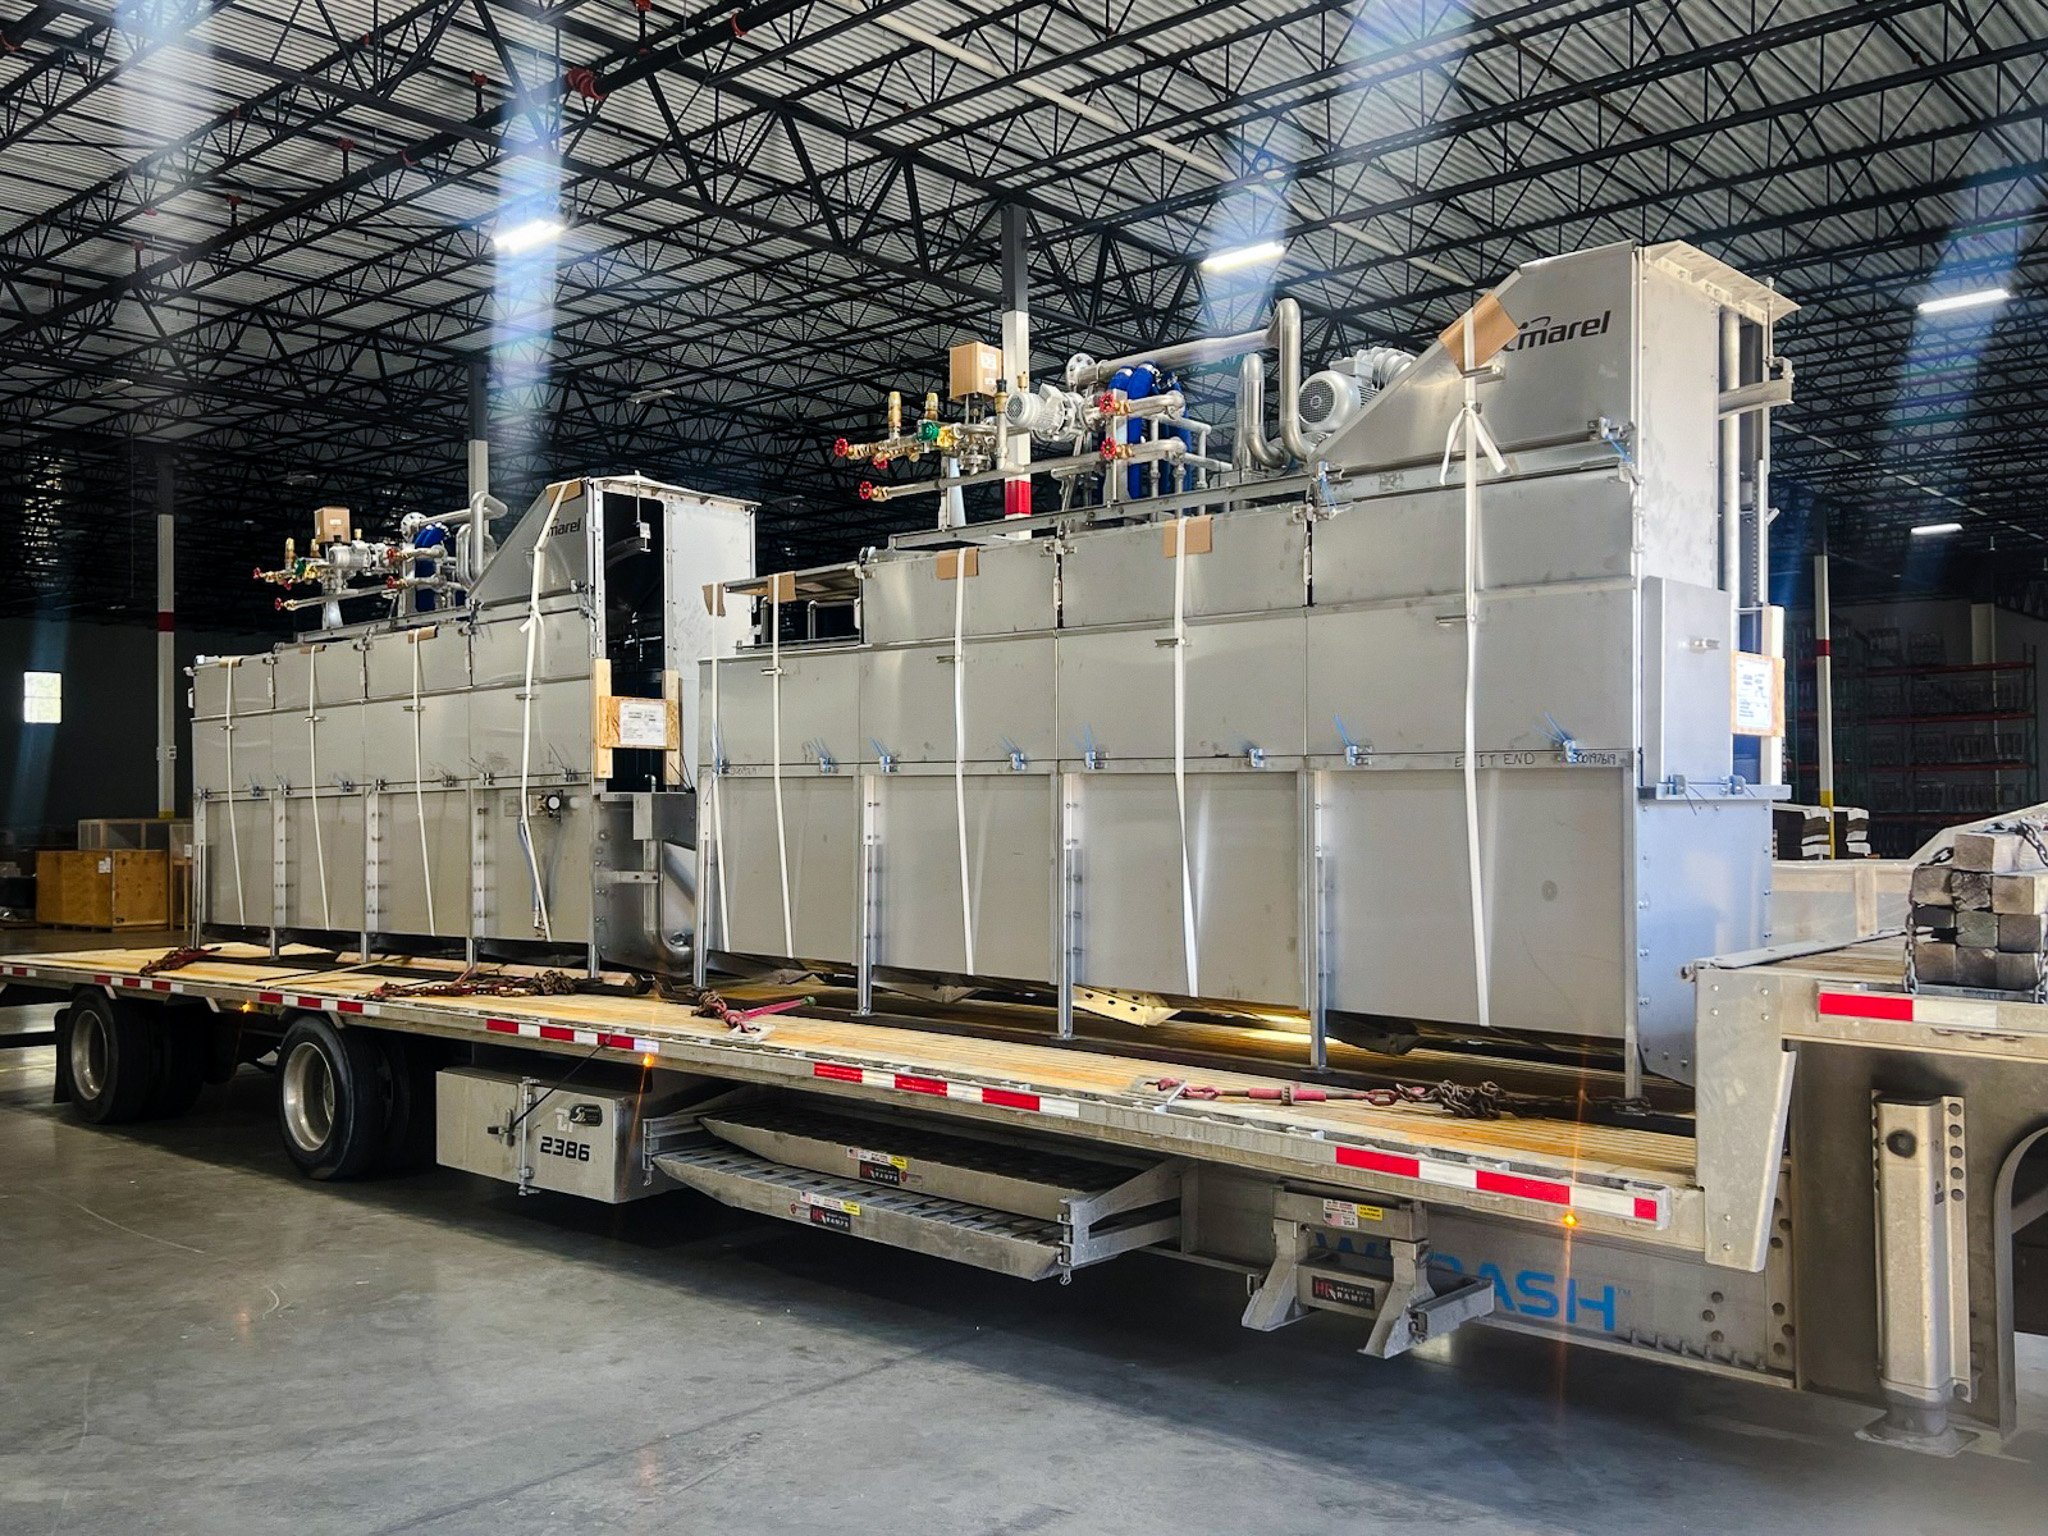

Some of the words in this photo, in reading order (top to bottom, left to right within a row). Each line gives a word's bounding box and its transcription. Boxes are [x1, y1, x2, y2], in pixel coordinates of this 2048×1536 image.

[1517, 310, 1612, 351] marel
[546, 517, 582, 538] marel
[1455, 754, 1496, 768] EIT
[1504, 752, 1535, 765] END
[541, 1136, 590, 1161] 2386
